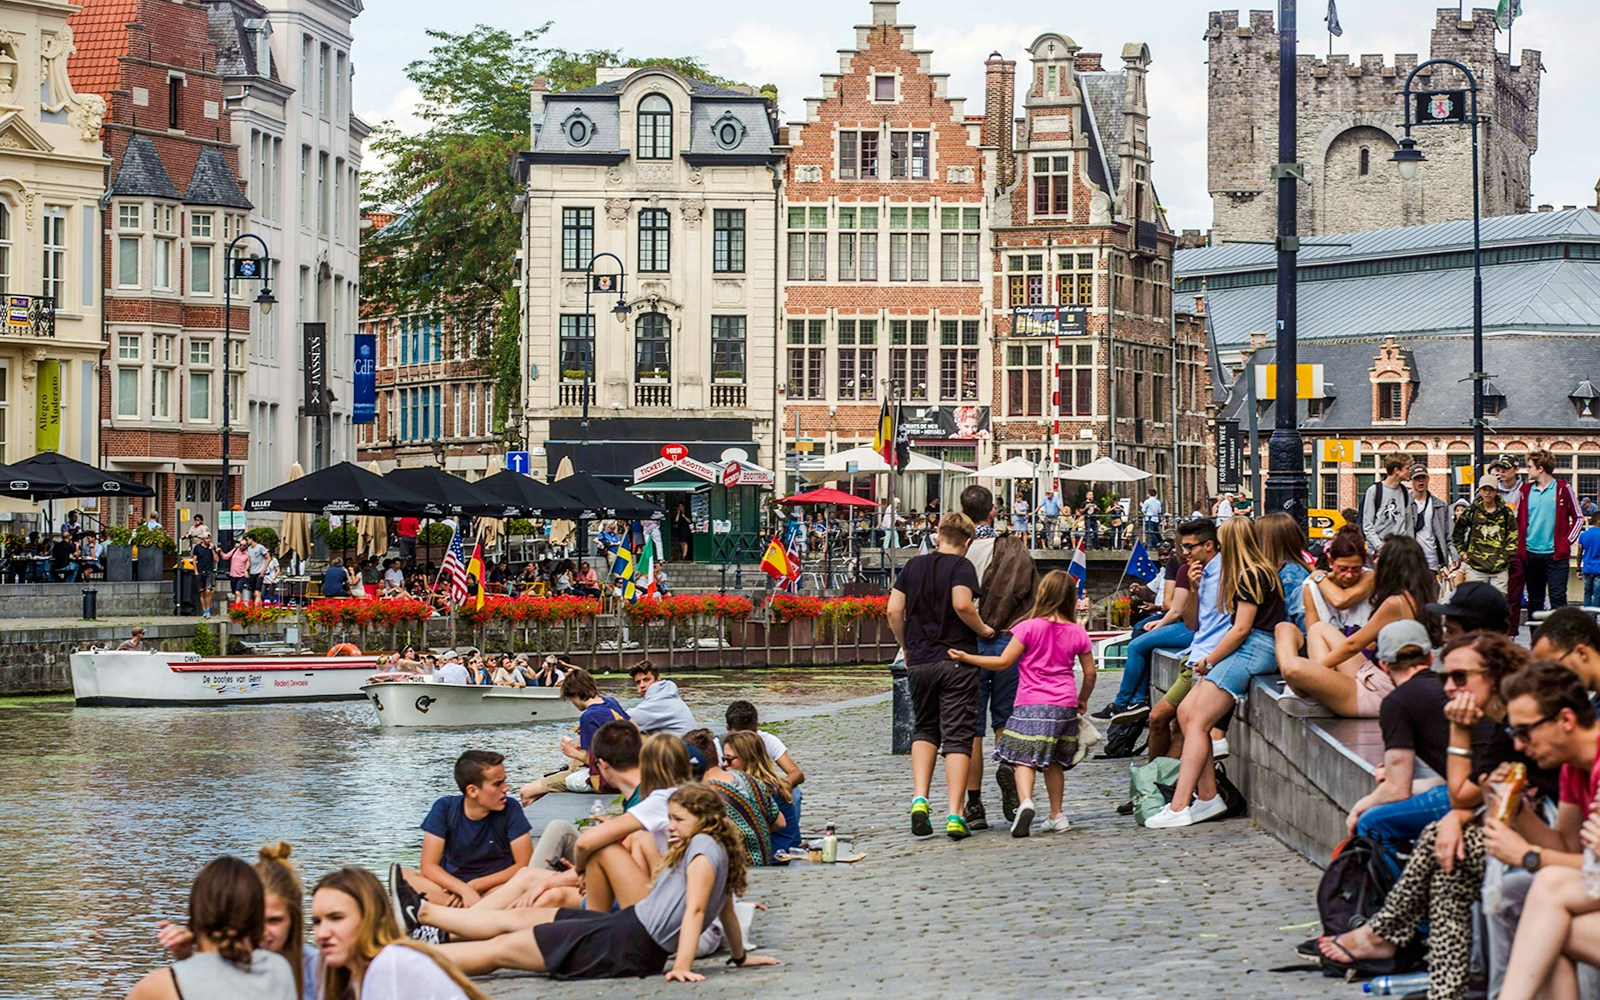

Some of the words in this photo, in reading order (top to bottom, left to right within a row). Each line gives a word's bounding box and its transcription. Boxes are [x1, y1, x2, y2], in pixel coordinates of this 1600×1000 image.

[308, 336, 320, 386] JANSSENS
[50, 376, 58, 425] Moderato
[39, 394, 49, 431] Allegro
[666, 447, 682, 455] HIER
[640, 460, 665, 475] TICKETS
[681, 459, 714, 477] BOOTTRIPS
[743, 472, 768, 481] BOOTTRIPS
[251, 500, 272, 508] LILLET
[203, 675, 210, 683] De
[213, 672, 233, 686] bootjes
[248, 674, 262, 683] Gent
[274, 679, 290, 688] Rederij
